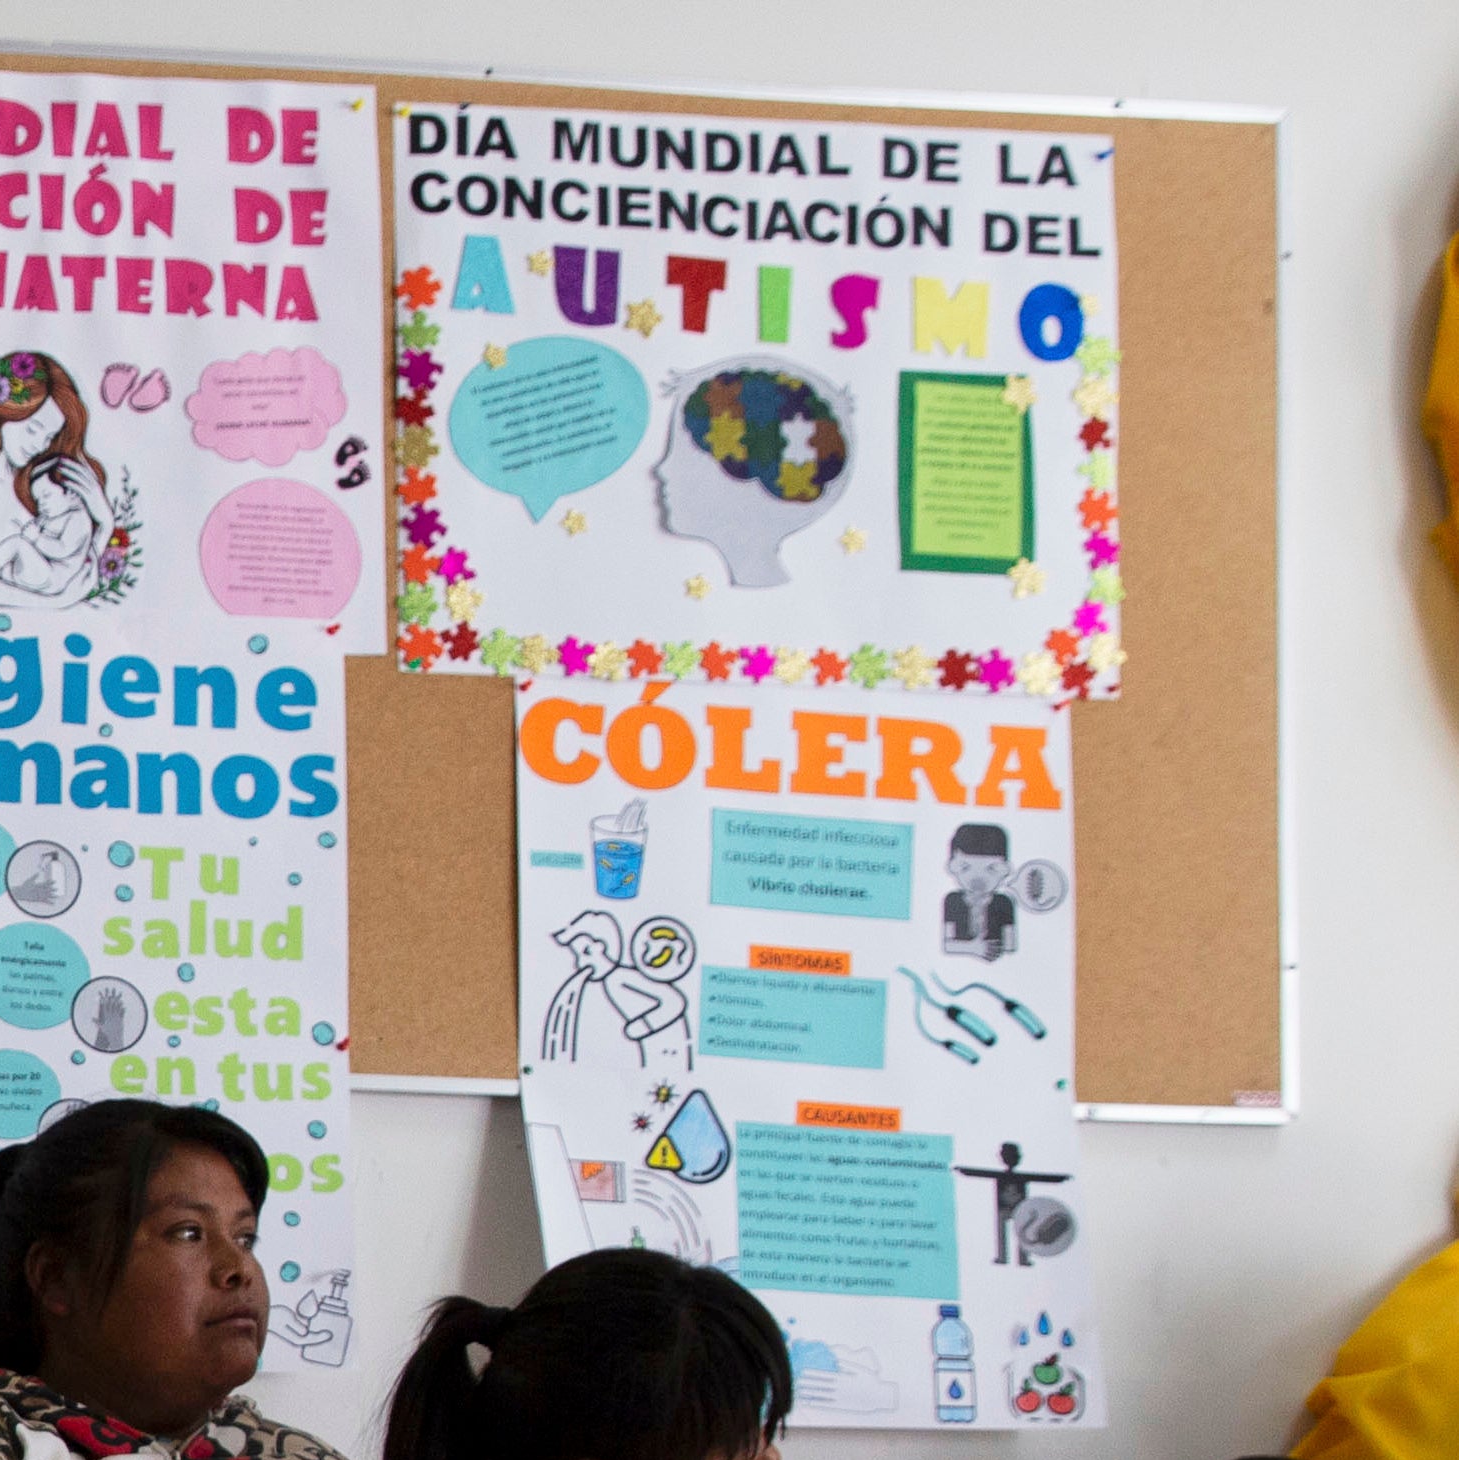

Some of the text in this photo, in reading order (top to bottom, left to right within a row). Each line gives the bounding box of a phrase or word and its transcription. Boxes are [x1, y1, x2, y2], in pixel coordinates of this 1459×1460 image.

[227, 108, 319, 165] DE
[409, 103, 1079, 186] DÍA MUNDIAL DE LA
[235, 187, 329, 246] DE
[409, 172, 1101, 258] CONCIENCIACIÓN DEL
[451, 234, 1085, 362] AUTISMO
[519, 680, 1062, 810] CÓLERA
[139, 845, 239, 900] Tu
[103, 900, 303, 960] salud
[154, 987, 301, 1037] esta
[109, 1051, 331, 1101] en tus
[804, 1108, 896, 1127] CAUSANTES
